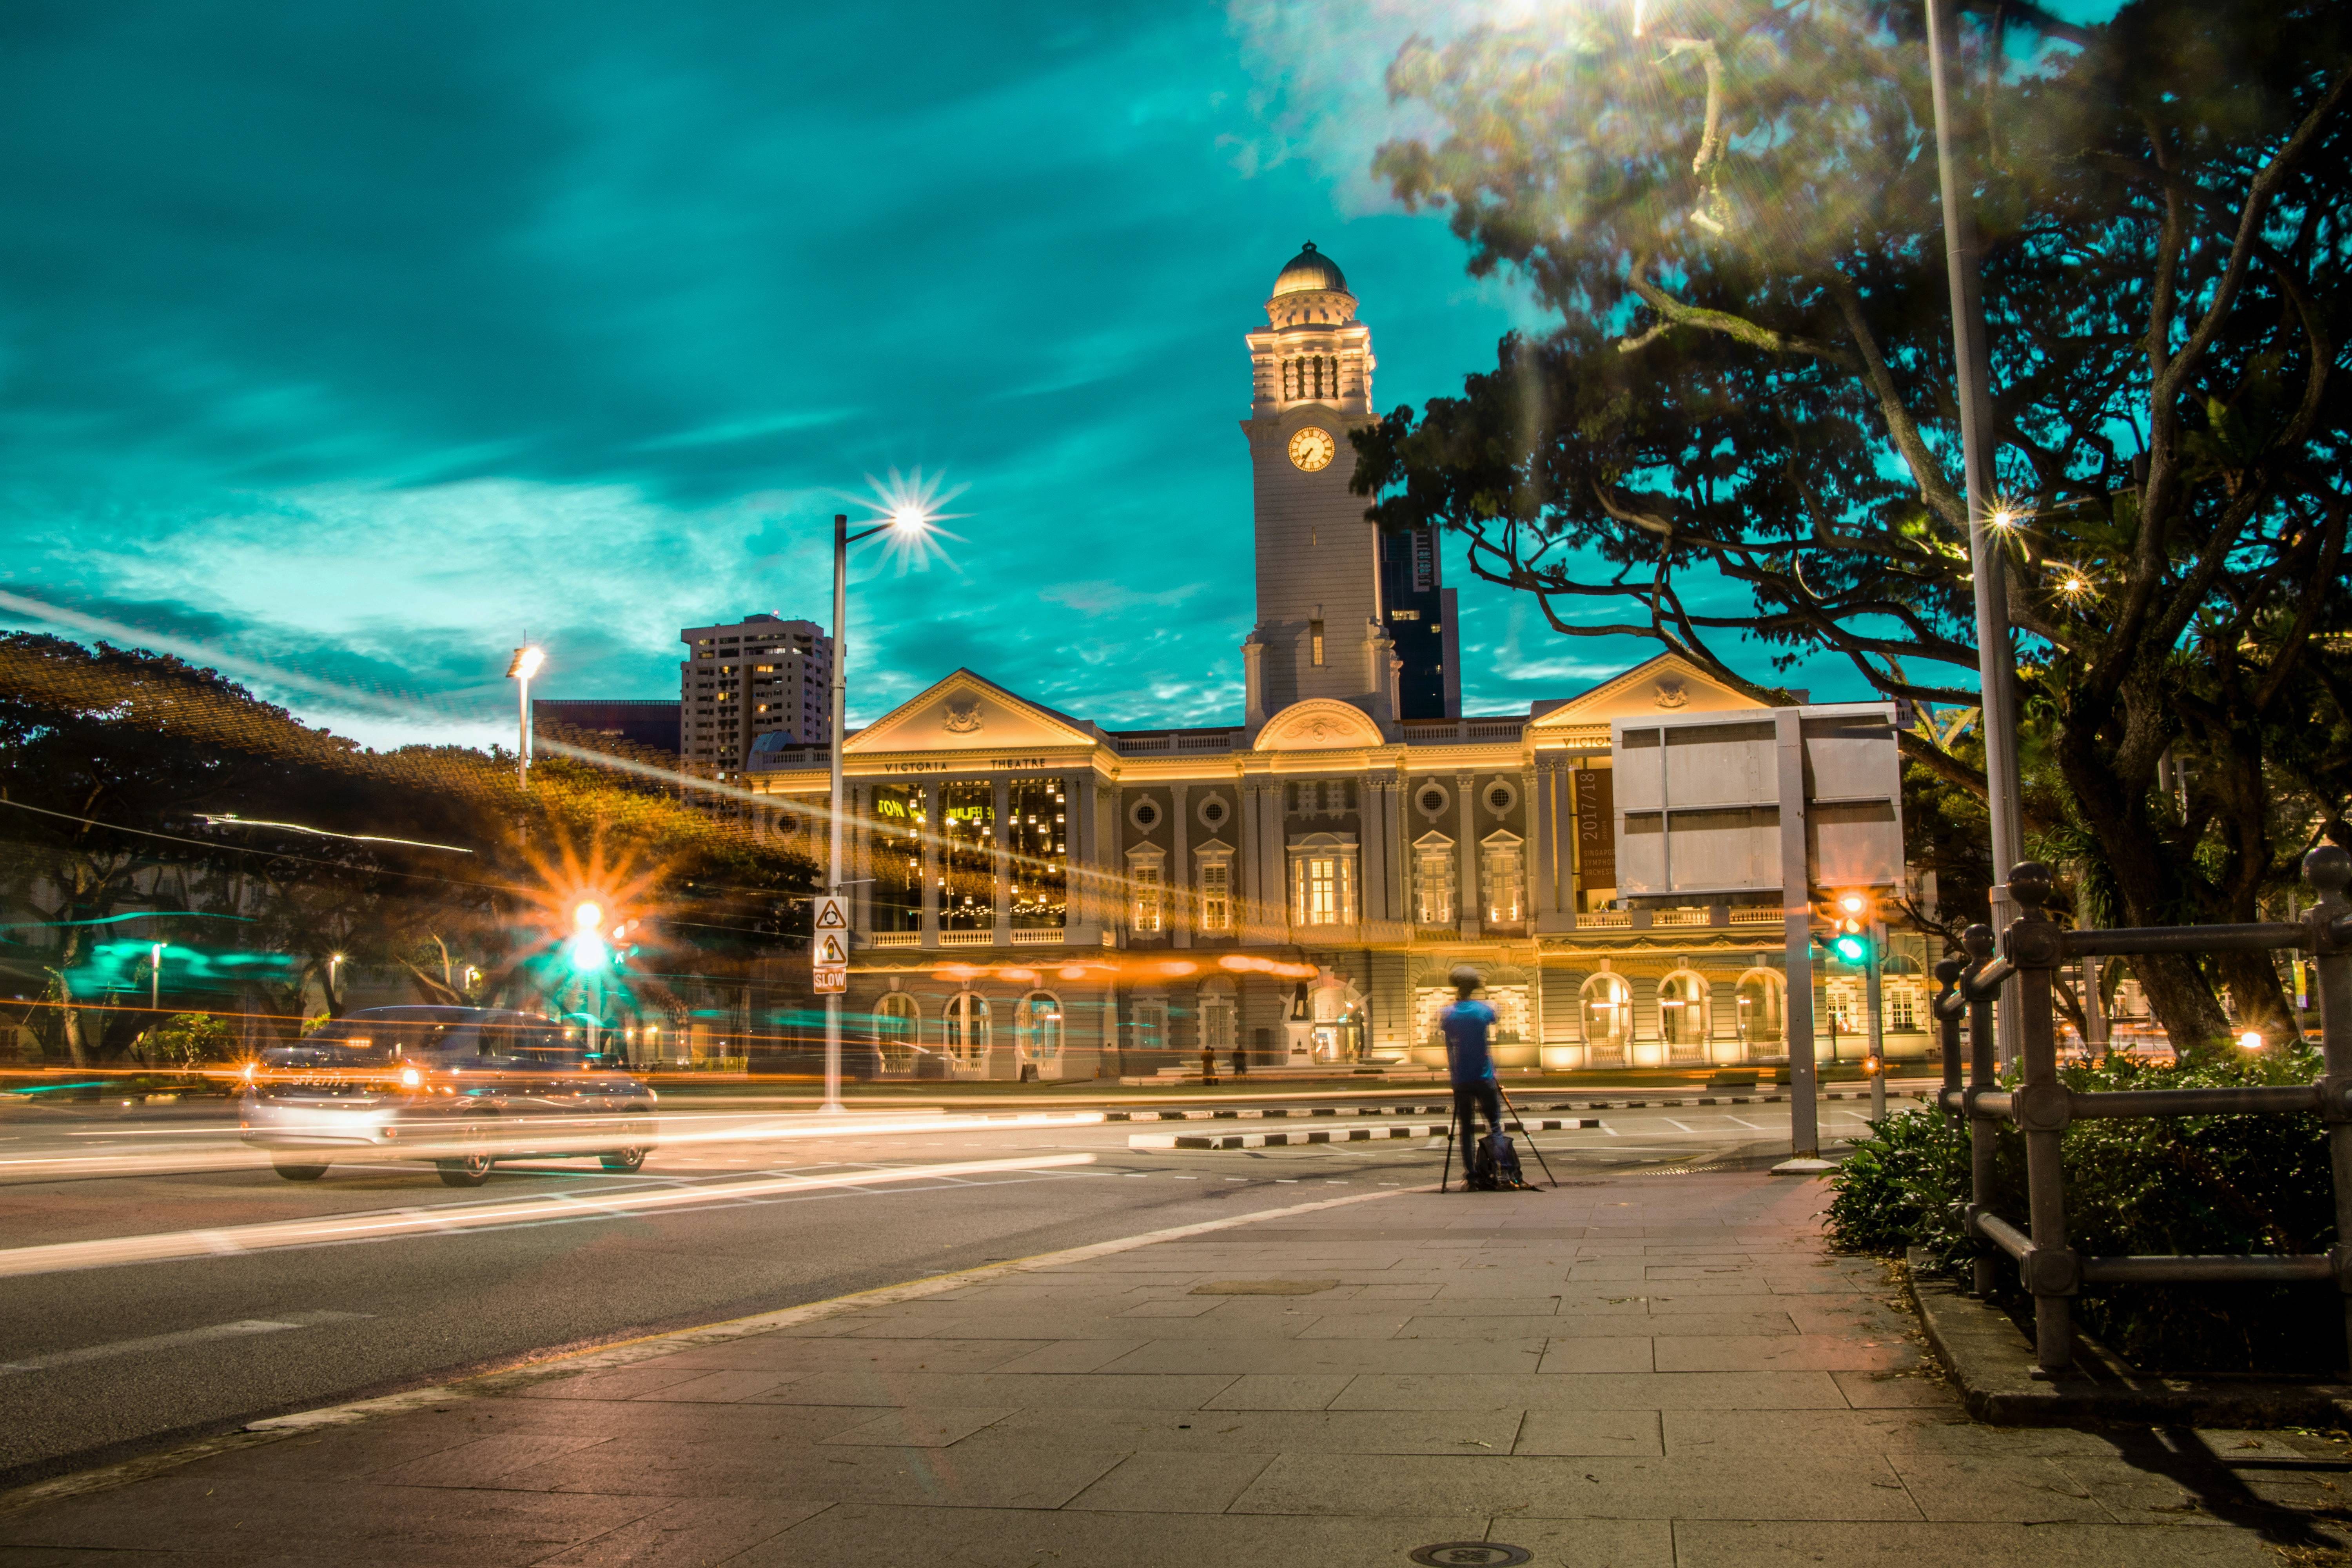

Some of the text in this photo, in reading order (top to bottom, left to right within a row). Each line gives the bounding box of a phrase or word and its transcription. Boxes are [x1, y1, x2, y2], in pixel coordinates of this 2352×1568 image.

[885, 758, 1045, 772] VICTORIA THEATRE
[1580, 773, 1598, 840] 2017/18
[815, 973, 845, 987] SLOW
